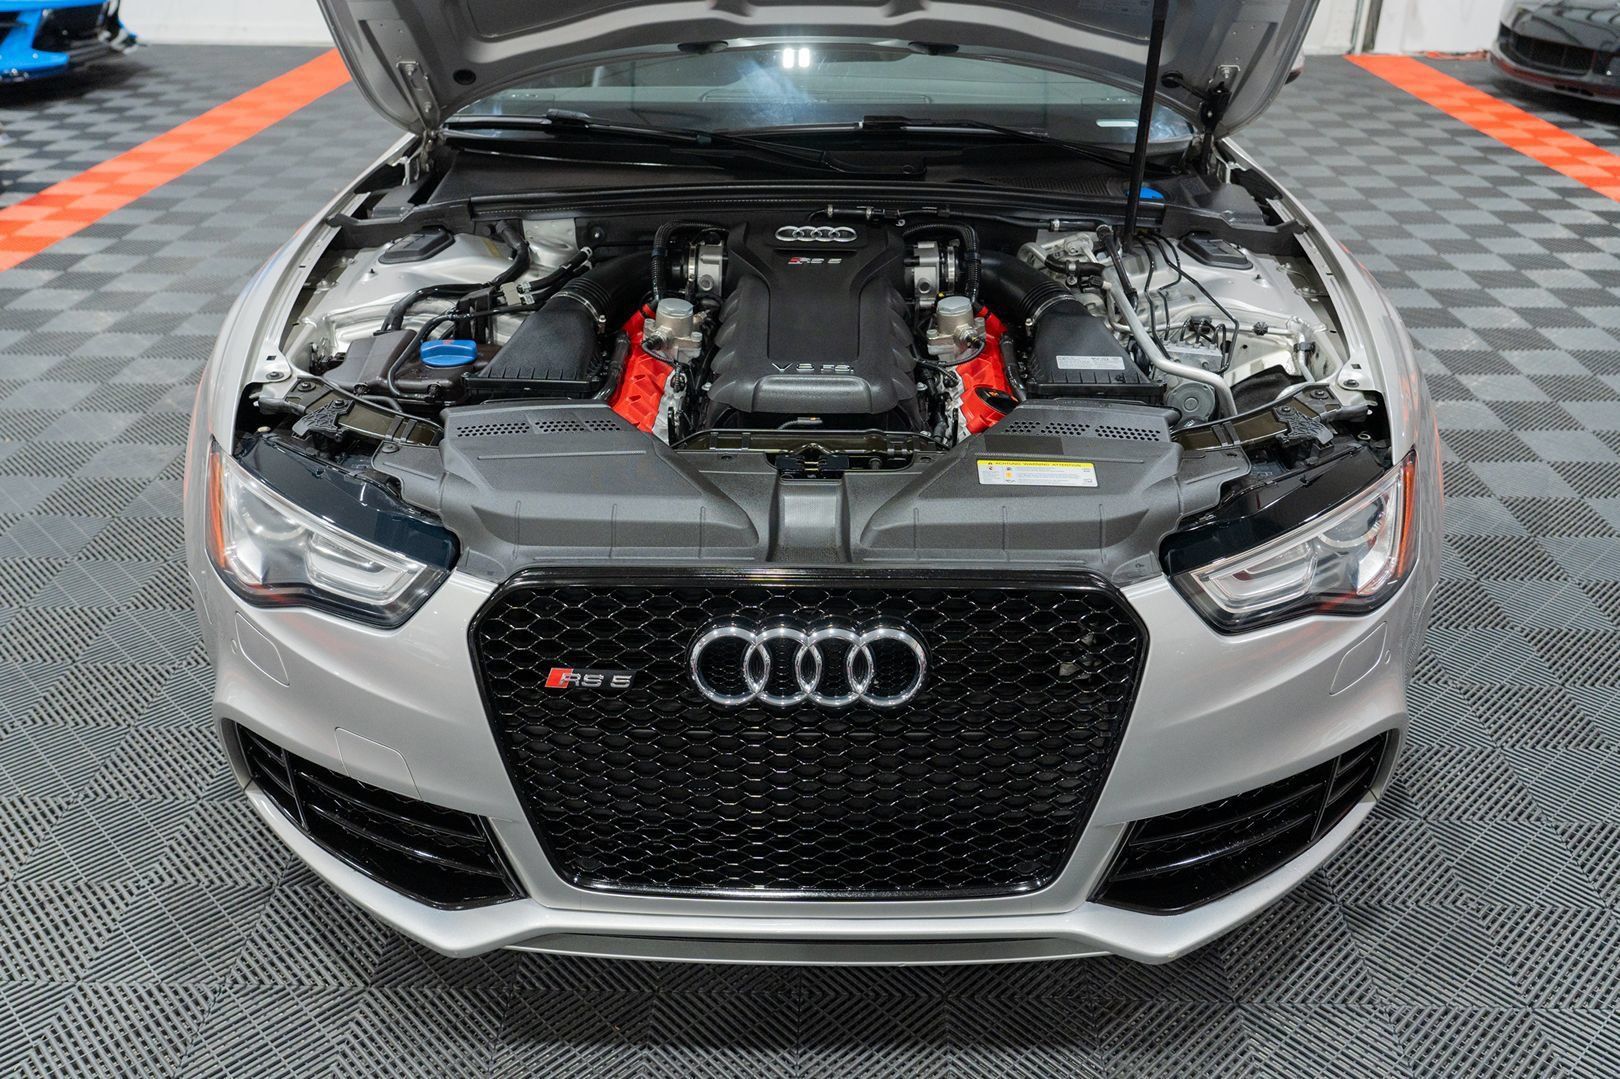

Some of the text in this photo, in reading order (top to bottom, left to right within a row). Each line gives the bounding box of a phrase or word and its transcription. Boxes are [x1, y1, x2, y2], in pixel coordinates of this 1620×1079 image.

[771, 361, 815, 374] V8
[559, 672, 632, 688] RS 5
